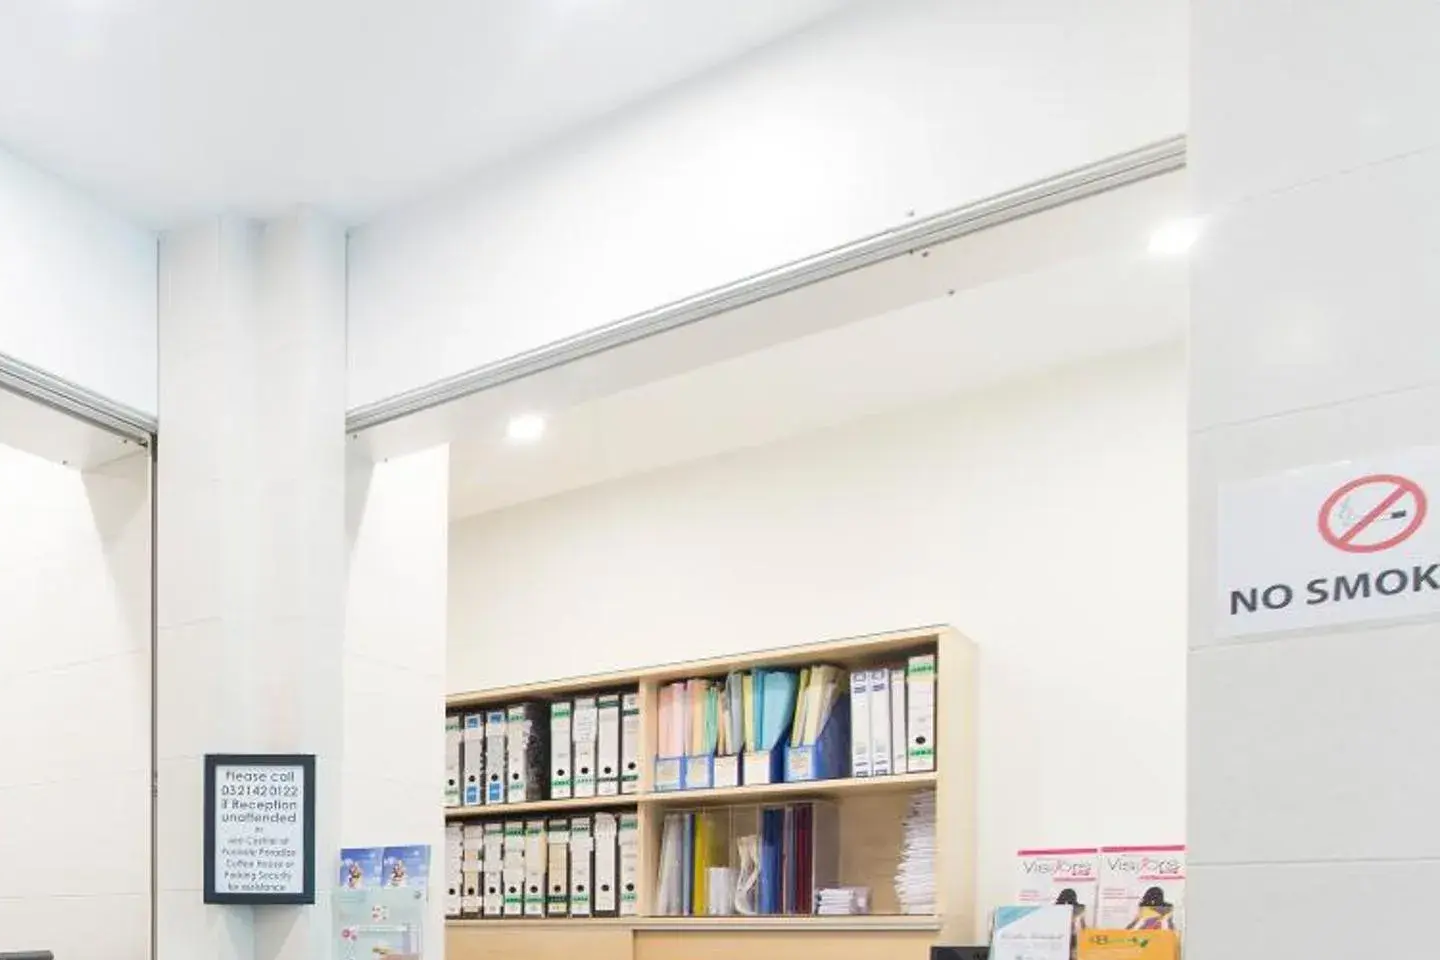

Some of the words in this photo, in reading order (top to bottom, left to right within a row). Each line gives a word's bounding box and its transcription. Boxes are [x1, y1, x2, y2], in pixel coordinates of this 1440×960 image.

[1230, 584, 1293, 615] NO
[1306, 564, 1440, 605] SMOK
[225, 771, 267, 782] Please
[270, 771, 295, 782] call
[232, 799, 297, 812] Reception
